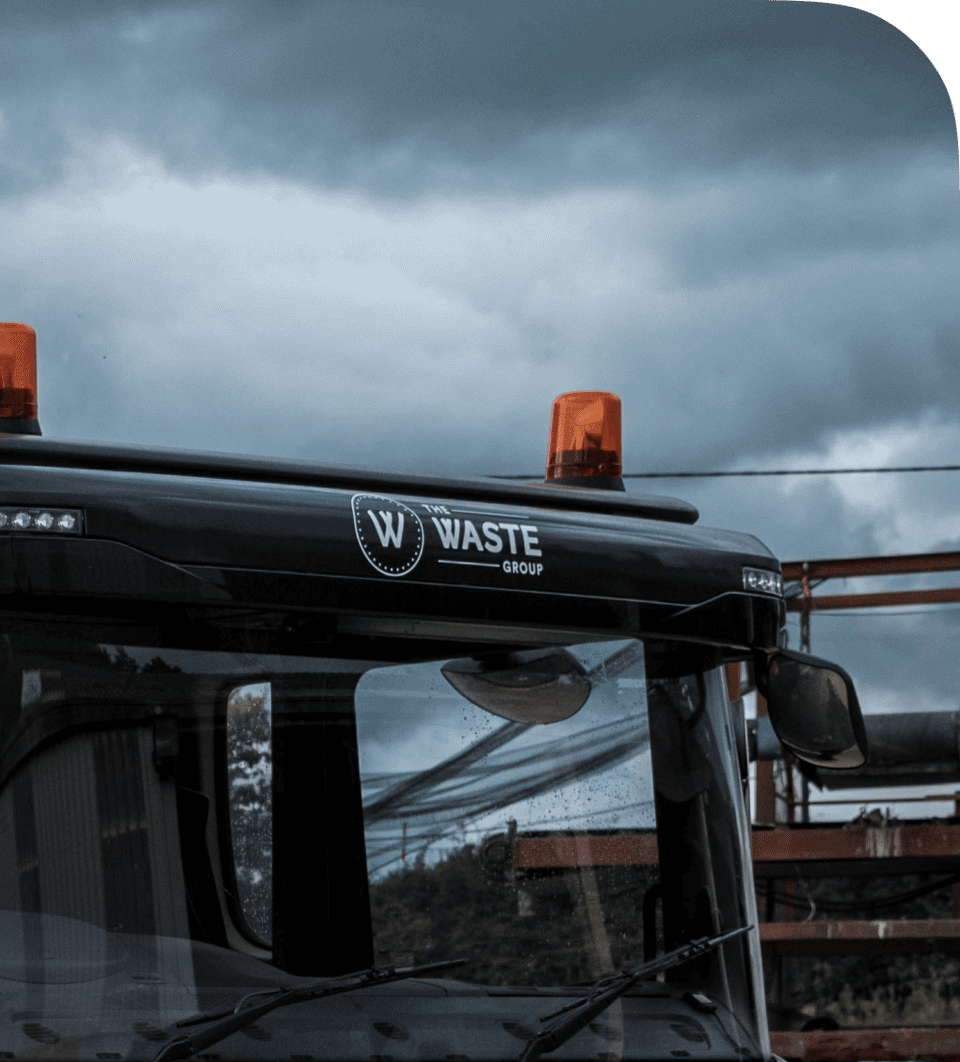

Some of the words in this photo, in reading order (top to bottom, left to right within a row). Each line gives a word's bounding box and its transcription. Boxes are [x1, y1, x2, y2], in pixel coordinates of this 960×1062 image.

[420, 502, 453, 516] THE
[366, 508, 405, 549] W
[430, 516, 543, 557] WASTE
[502, 559, 544, 576] GROUP
